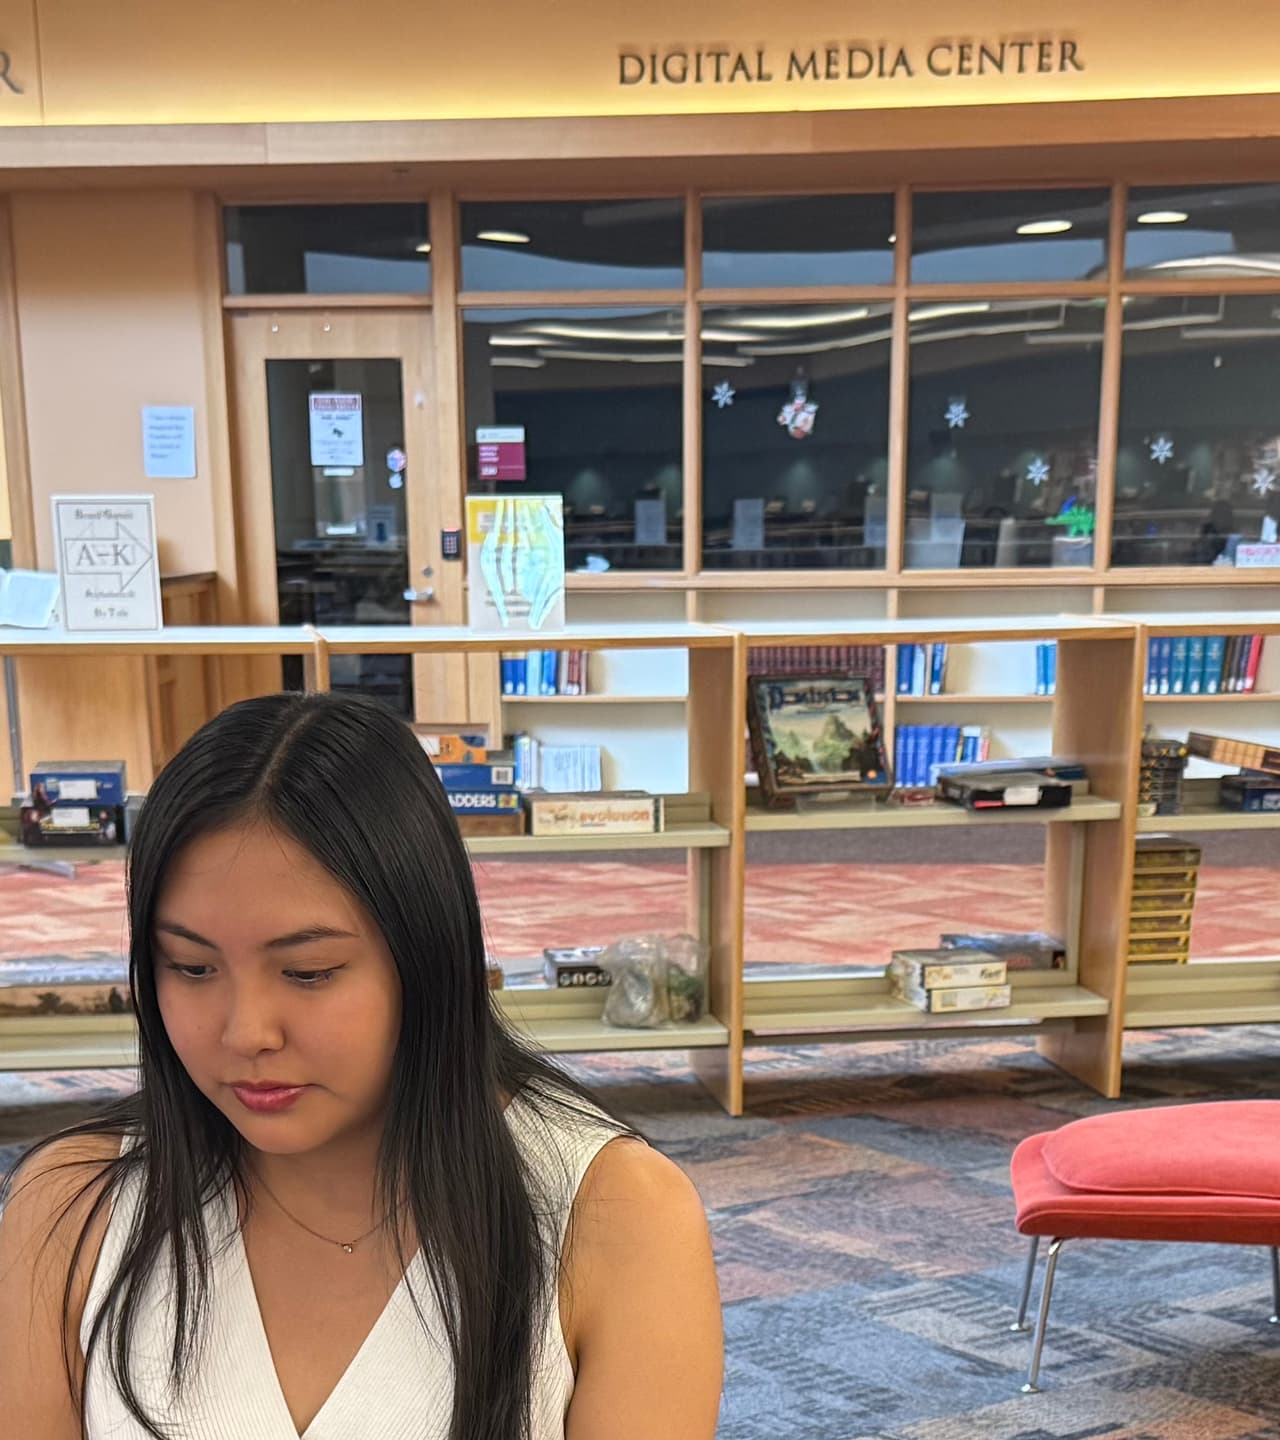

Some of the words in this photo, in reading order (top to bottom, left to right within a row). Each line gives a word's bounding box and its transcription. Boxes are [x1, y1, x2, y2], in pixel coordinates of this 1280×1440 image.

[619, 50, 772, 85] DIGITAL
[786, 47, 914, 81] MEDIA
[927, 41, 1085, 78] CENTER
[579, 805, 651, 823] evolution
